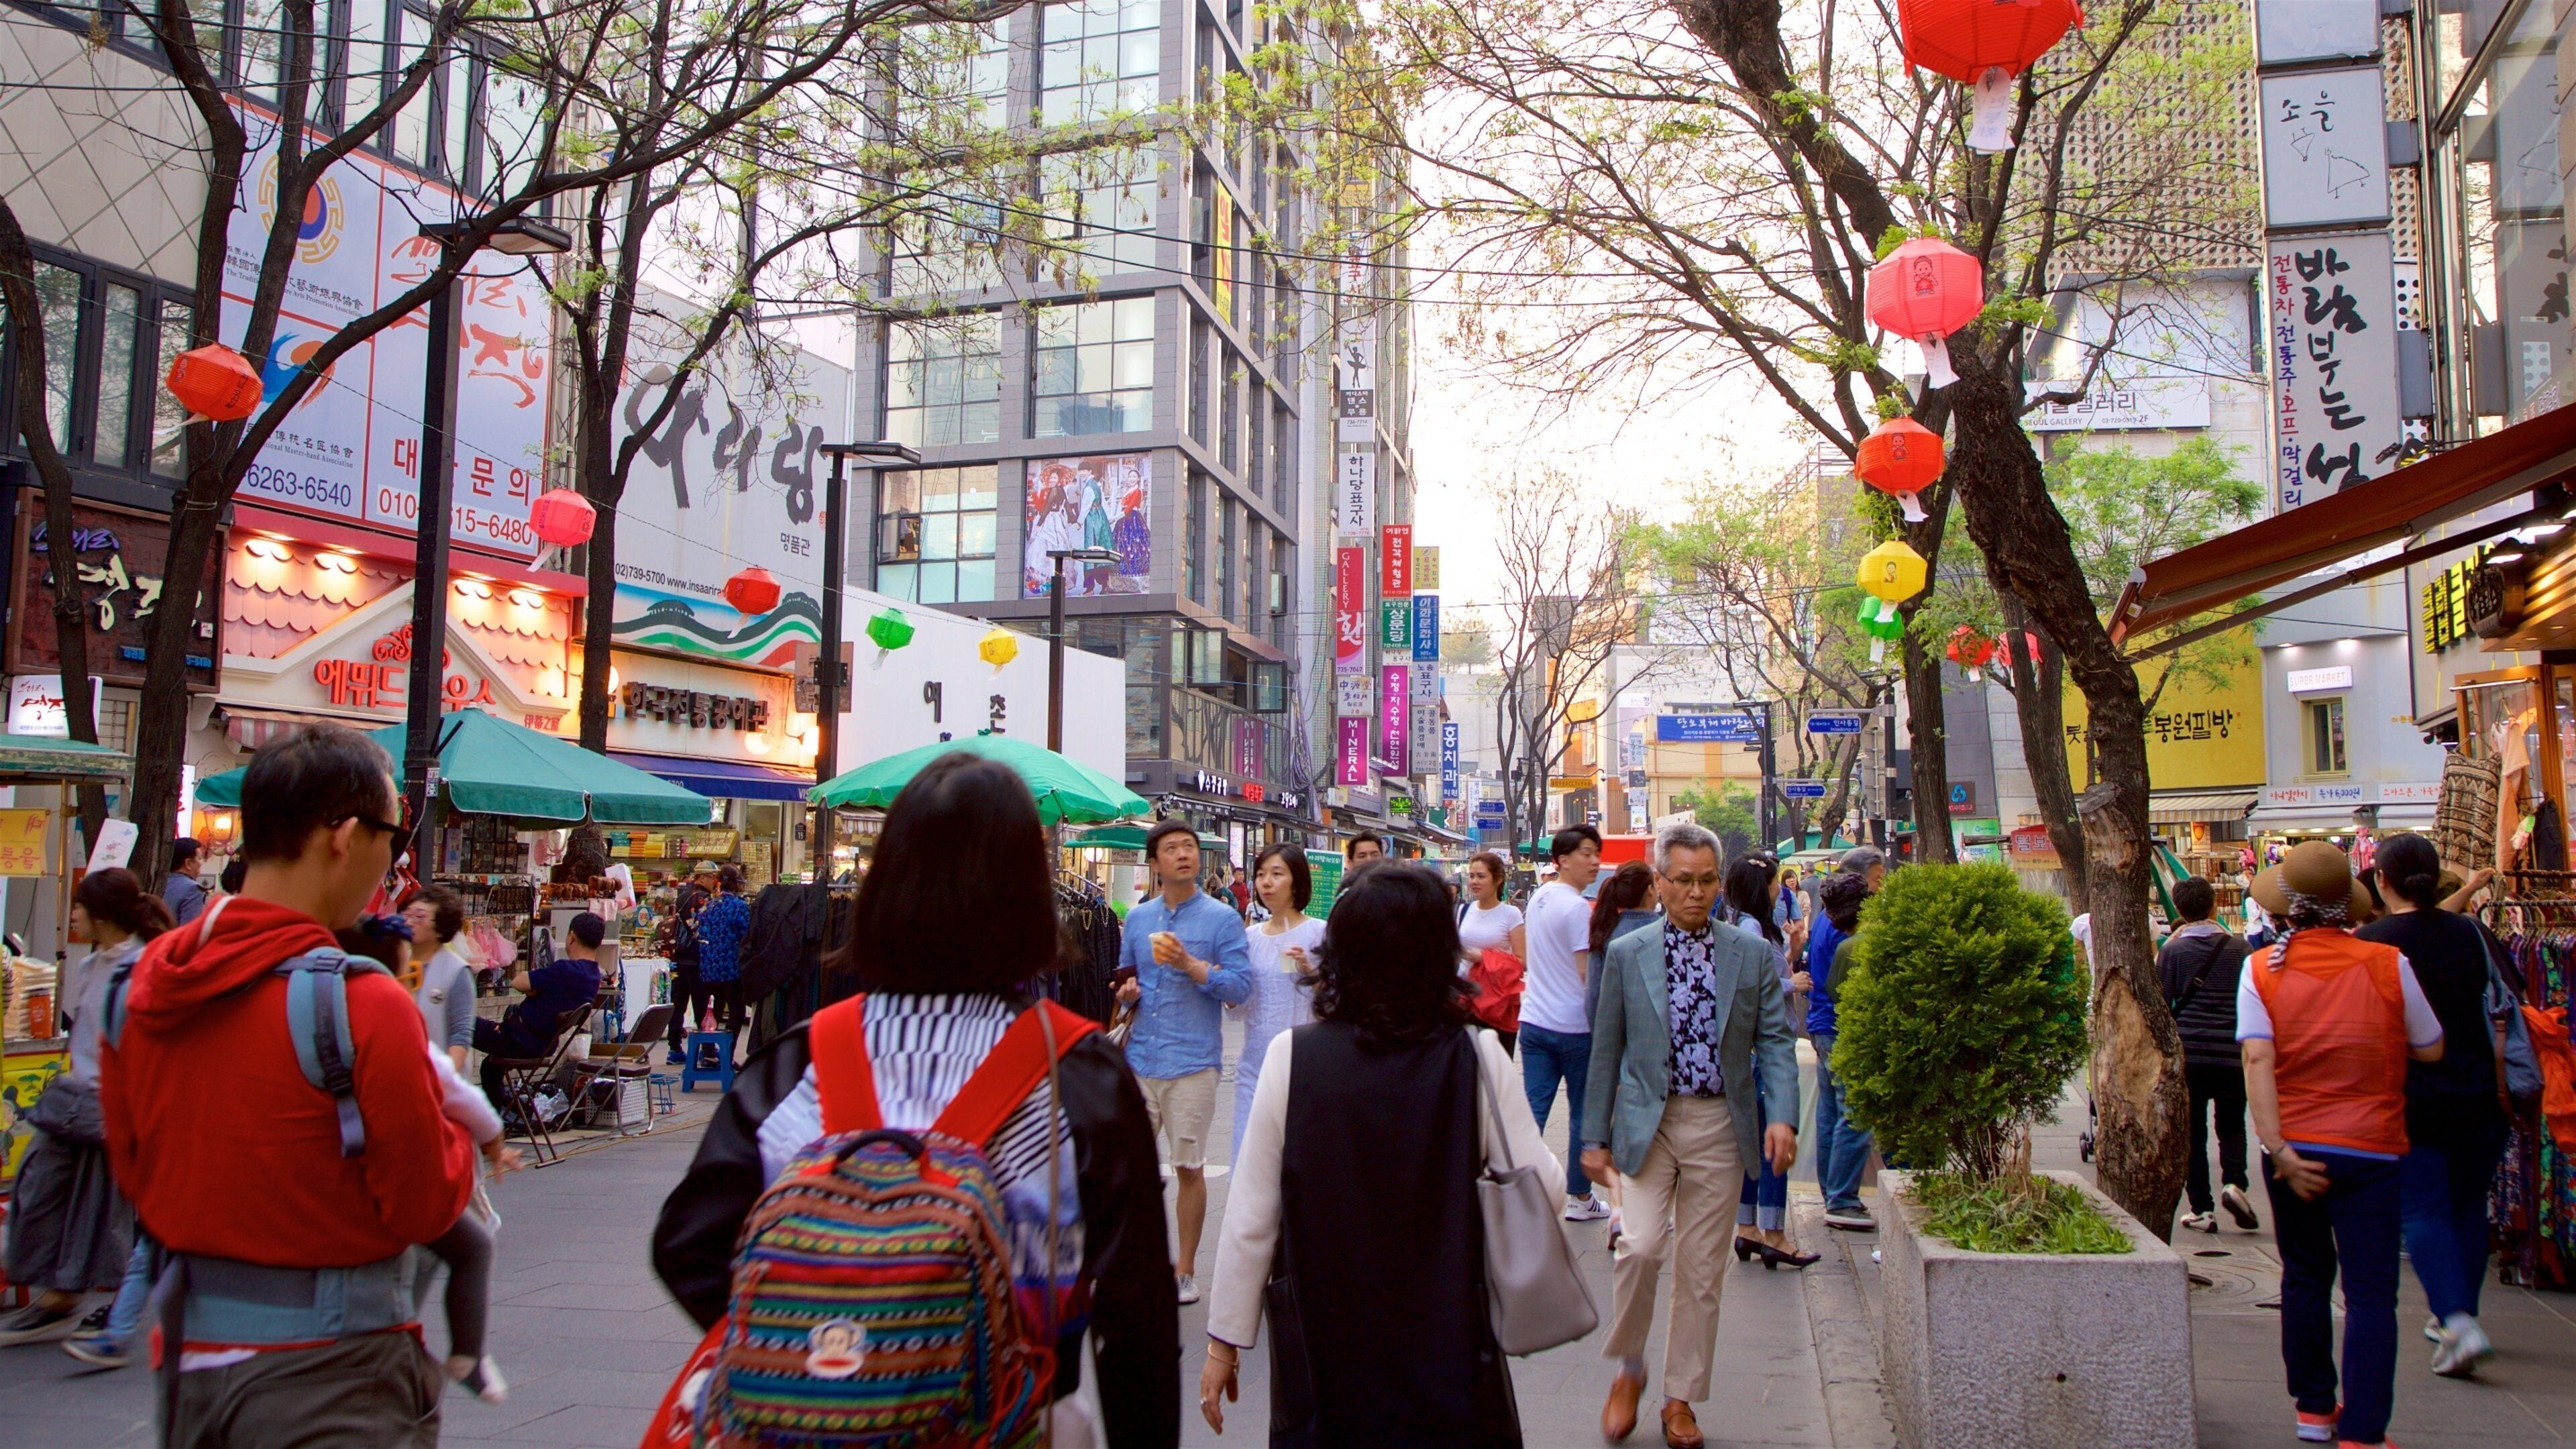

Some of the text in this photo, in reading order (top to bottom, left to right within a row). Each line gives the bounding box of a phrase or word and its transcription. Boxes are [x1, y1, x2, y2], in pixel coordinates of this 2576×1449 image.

[226, 268, 237, 276] The
[305, 294, 334, 309] Promotion
[2025, 418, 2049, 426] SEOUL
[2050, 417, 2083, 425] GALLERY
[2139, 415, 2149, 423] 2F
[321, 455, 354, 469] Association
[1348, 455, 1364, 527] 하나당표구사
[780, 532, 810, 557] 명품관
[615, 562, 723, 597] 02)739-5700 www.insaarira
[1341, 552, 1350, 608] GALLERY
[1419, 597, 1432, 649] 이화문화사
[1417, 663, 1434, 672] 노송
[2289, 671, 2346, 687] SUPER MARKET
[1419, 672, 1432, 698] 표구사
[627, 682, 770, 734] 한국전통공예관
[2154, 708, 2233, 743] 봉원필방
[1348, 719, 1358, 782] MINERAL
[1443, 726, 1458, 788] 홍치과
[1443, 788, 1458, 798] 의원
[797, 830, 804, 840] 19
